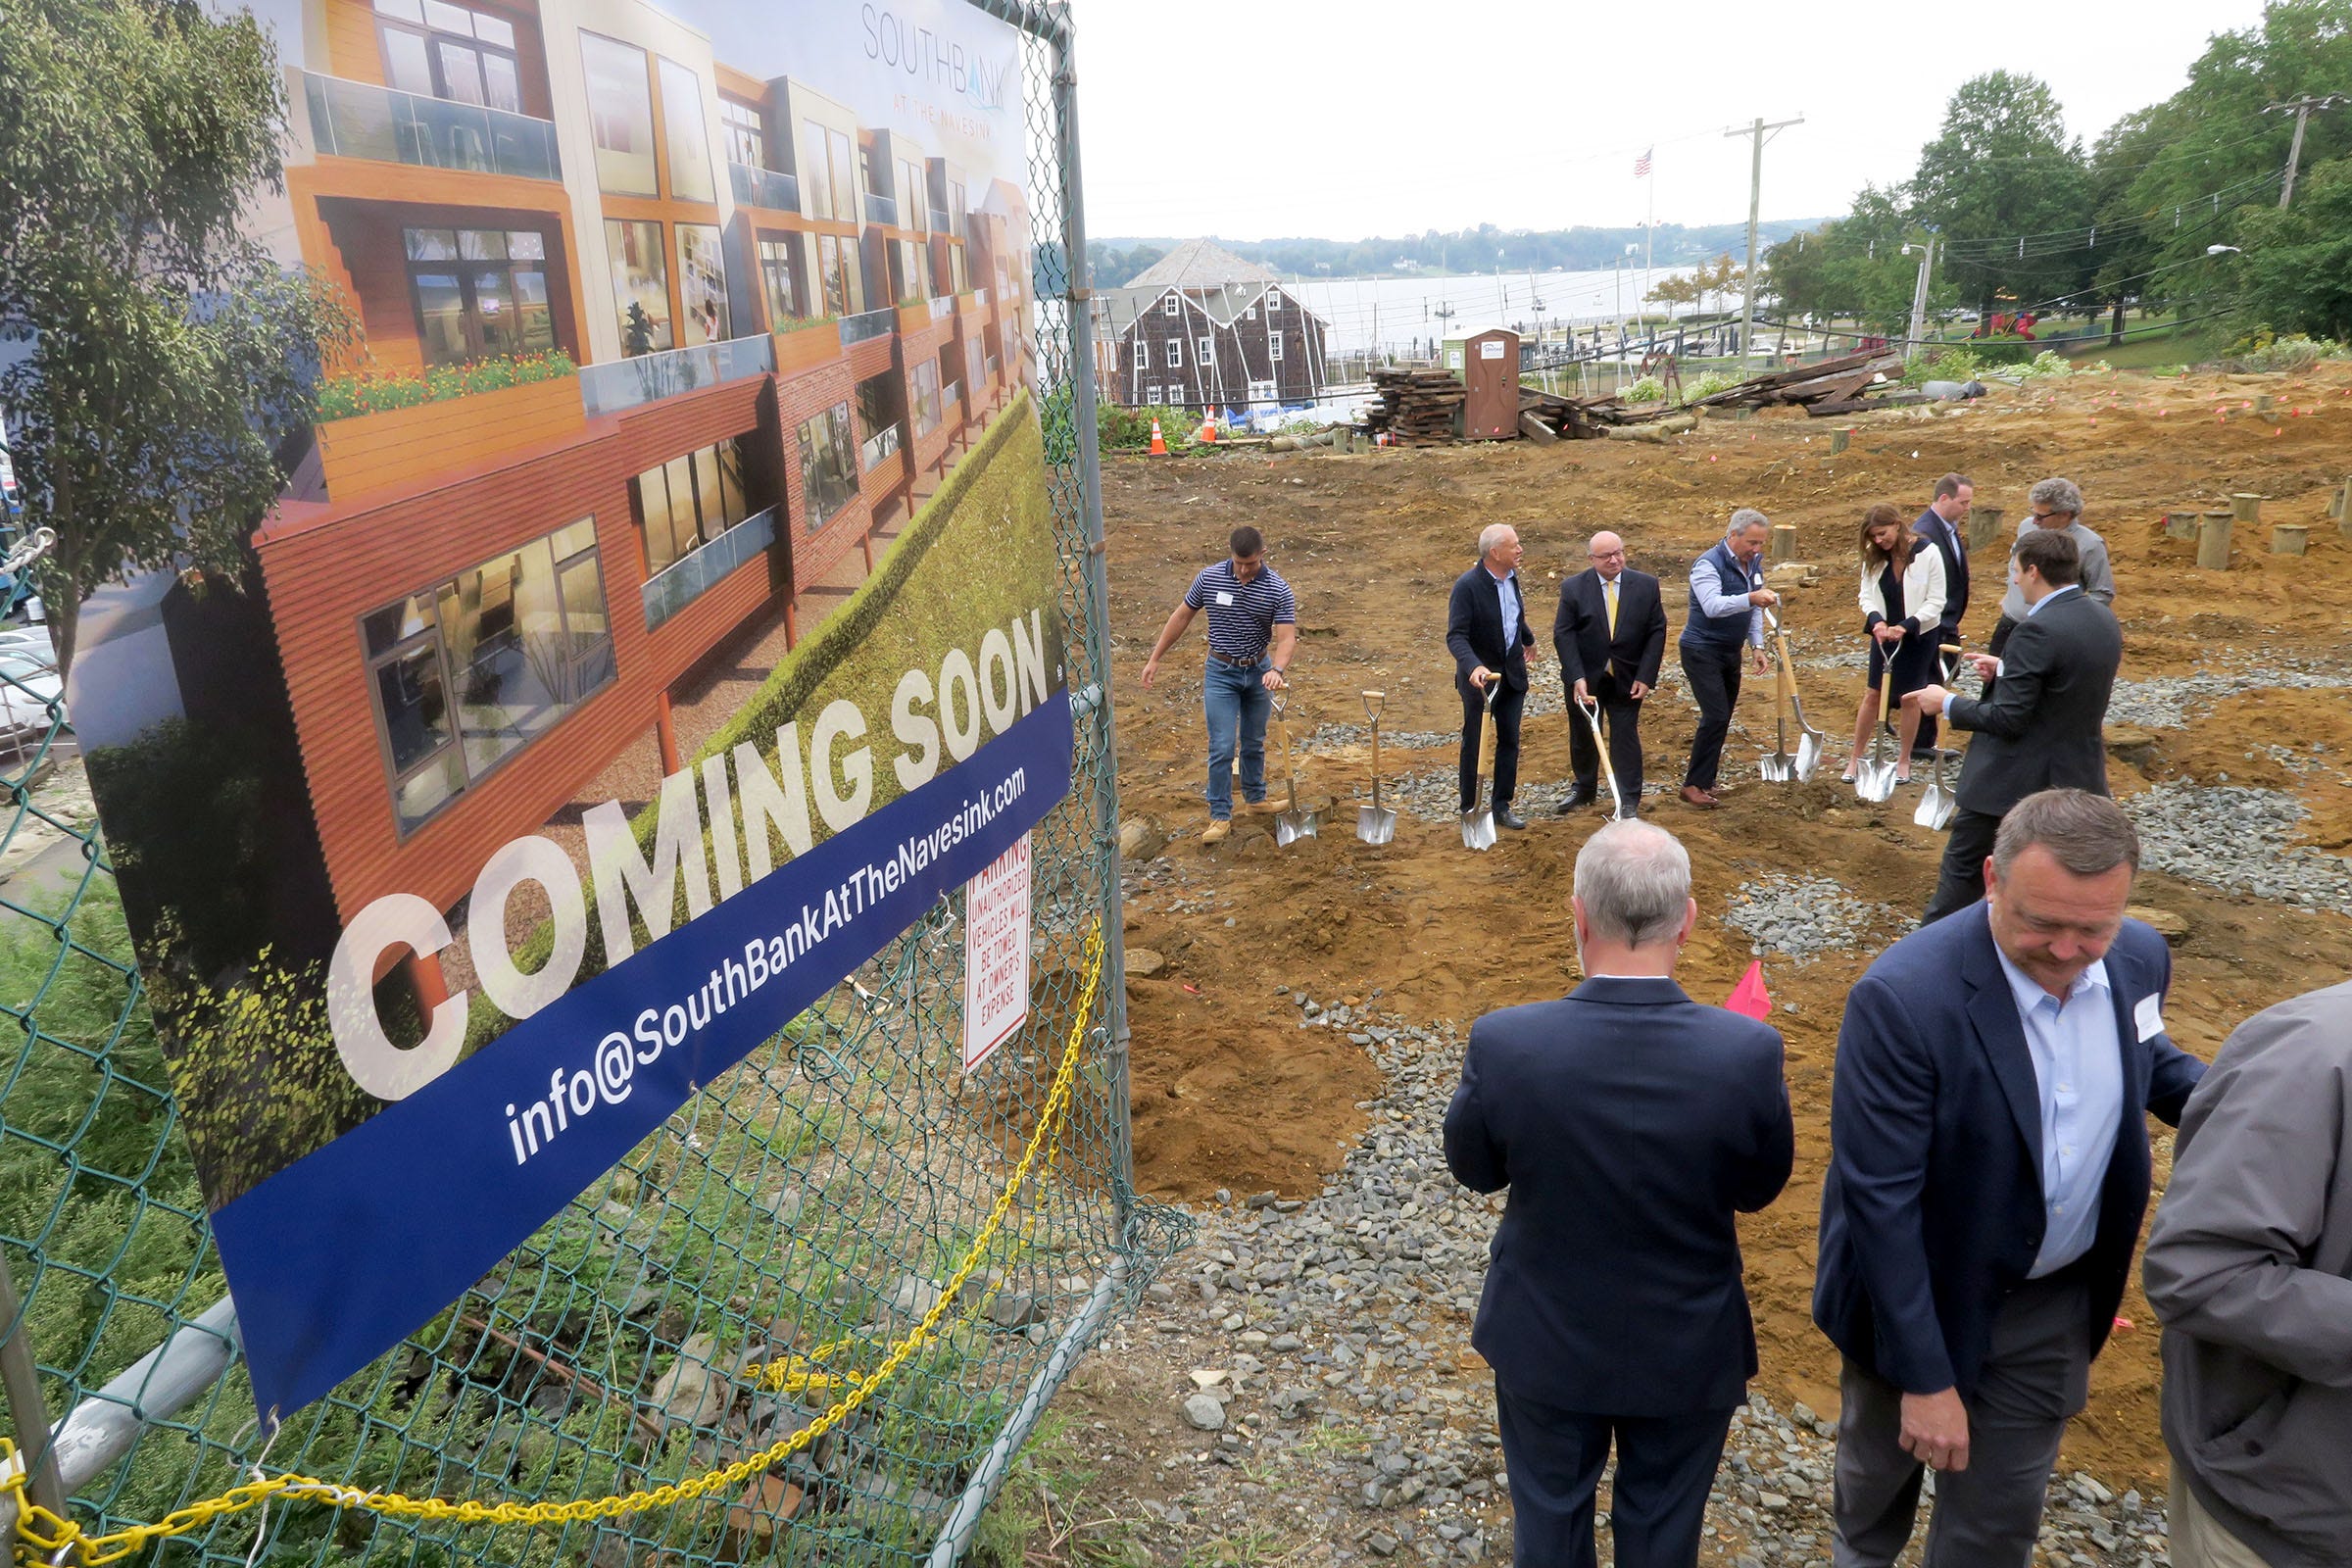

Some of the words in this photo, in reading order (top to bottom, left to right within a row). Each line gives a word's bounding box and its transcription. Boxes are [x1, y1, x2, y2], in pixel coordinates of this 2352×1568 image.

[893, 93, 906, 115] AT
[912, 99, 934, 124] THE
[940, 109, 992, 142] NAVESINK
[326, 697, 874, 1102] COMING
[890, 608, 1048, 792] SOON
[971, 868, 1027, 923] UNAUTHORIZED
[972, 907, 1008, 951] VEHICLES
[1010, 895, 1026, 922] WILL
[982, 947, 991, 972] BE
[994, 928, 1017, 962] TOWED
[505, 764, 1026, 1165] info@SouthBankAtTheNavesink.com
[976, 978, 987, 1004] AT
[989, 951, 1020, 994] OWNER'S
[982, 981, 1014, 1027] EXPENSE
